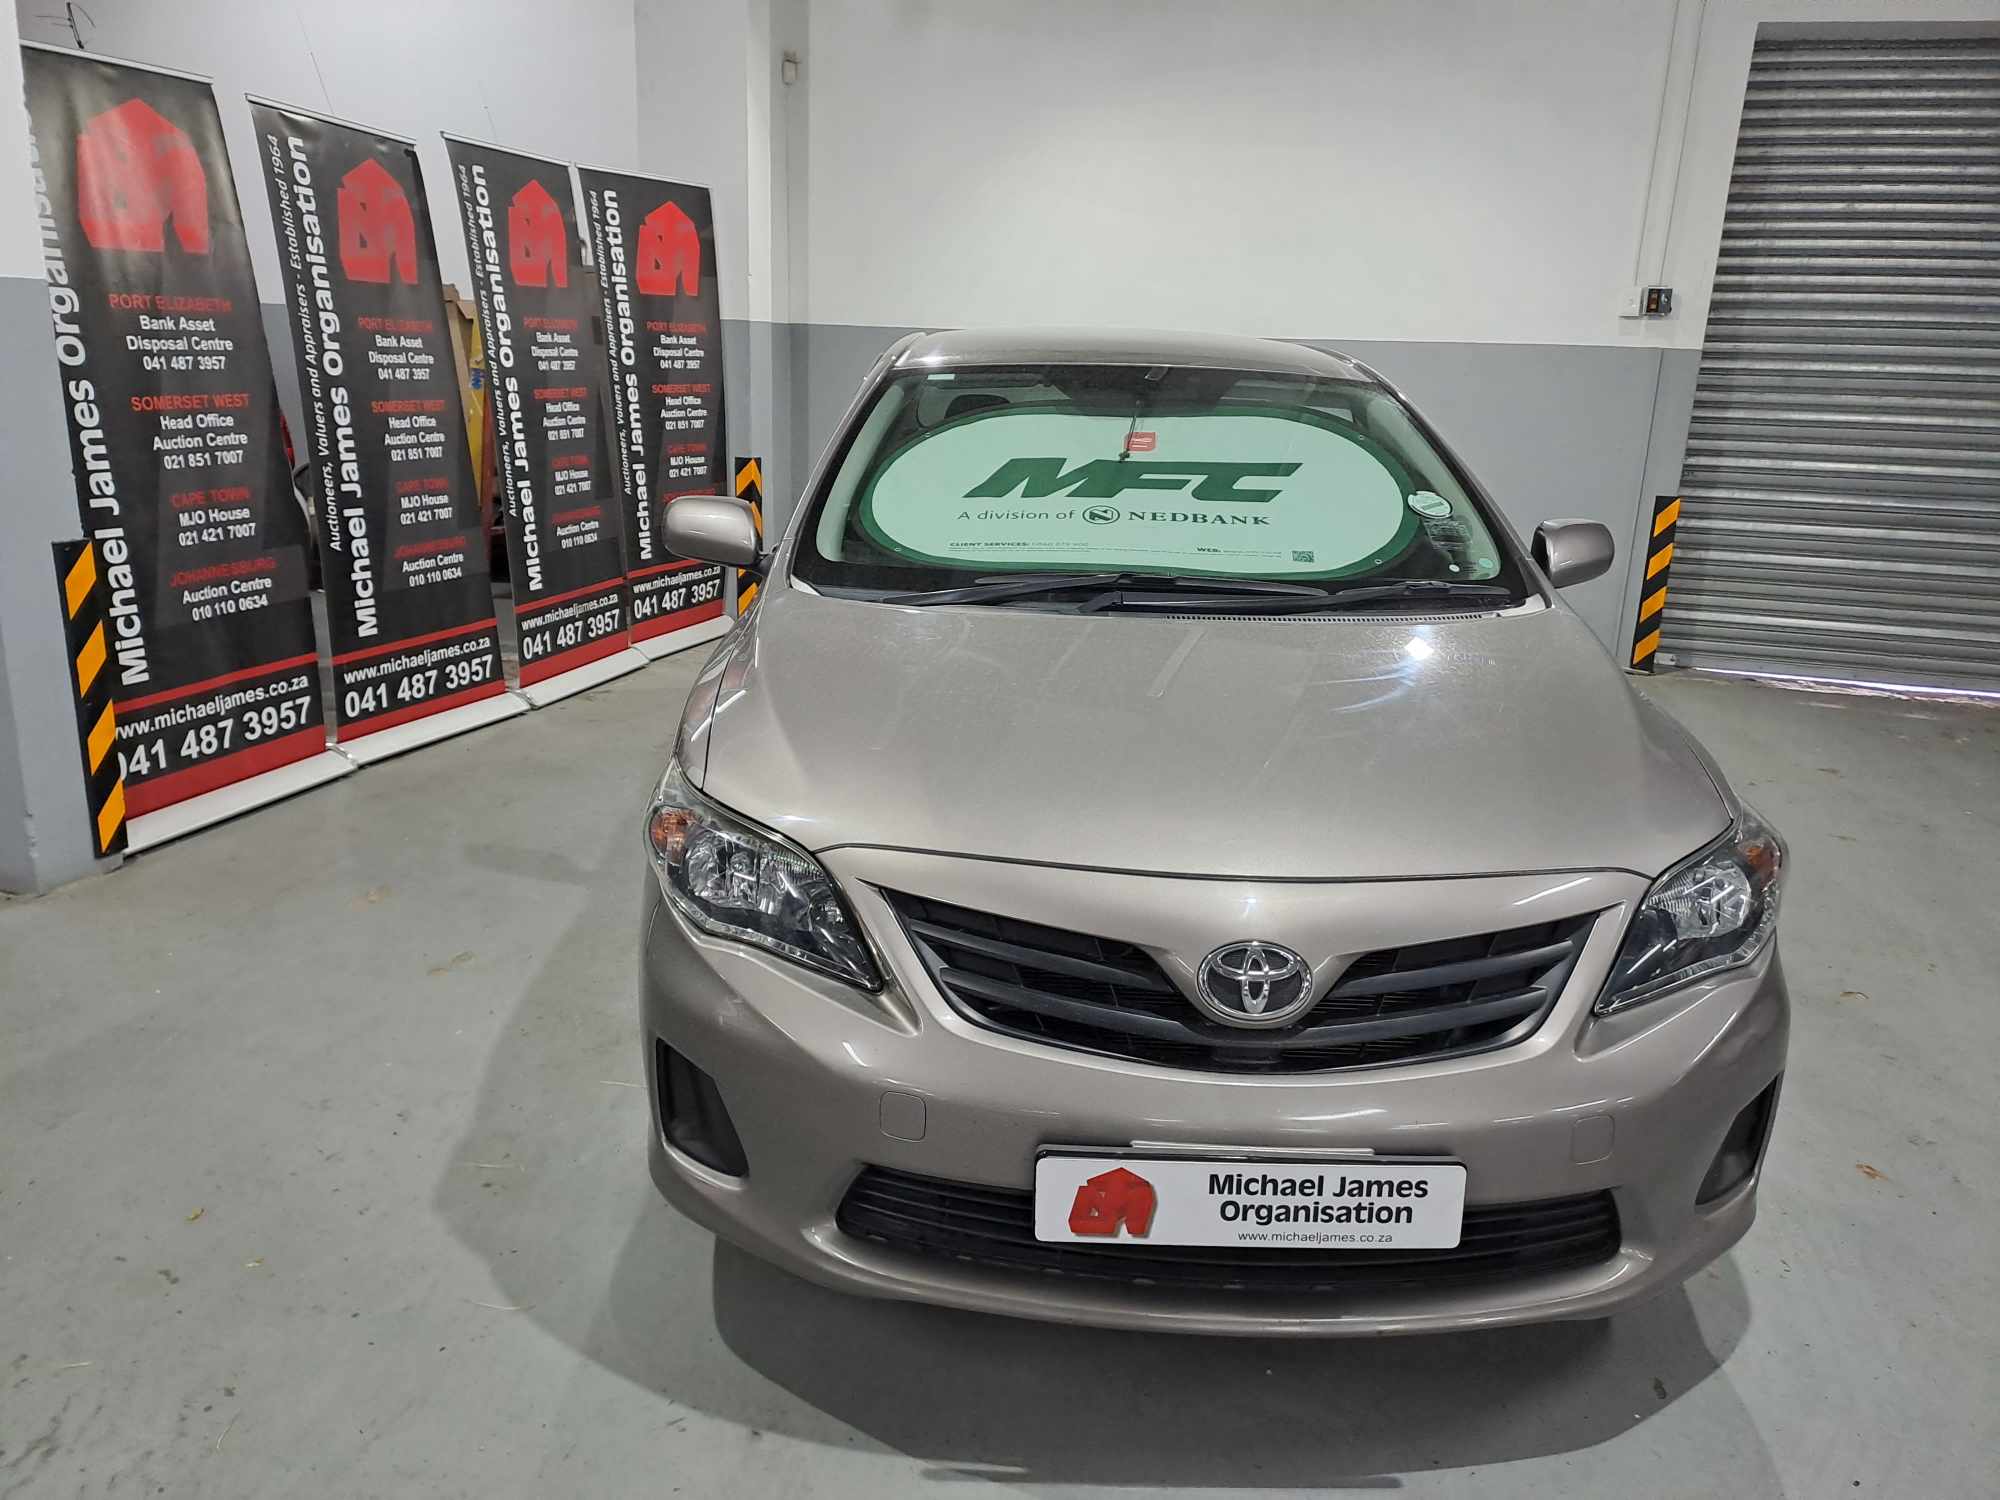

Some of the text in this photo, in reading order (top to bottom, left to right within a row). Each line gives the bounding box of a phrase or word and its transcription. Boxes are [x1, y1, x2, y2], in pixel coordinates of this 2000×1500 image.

[472, 164, 514, 368] Organisation
[108, 293, 151, 309] PORT
[139, 315, 216, 332] Bank Asset
[480, 288, 497, 358] Appraisers
[604, 298, 618, 361] Appraisers
[126, 336, 233, 352] Disposal Centre
[267, 134, 342, 551] Auctioneers, Valuers and Appraisers Established 1964
[375, 334, 423, 348] Bank Asset
[143, 356, 226, 370] 041 487 3957
[368, 351, 434, 365] Disposal Centre
[610, 359, 620, 381] and
[378, 368, 393, 380] 041
[395, 368, 410, 380] 487
[488, 359, 499, 386] and
[603, 190, 653, 560] Michael James Organisation
[288, 136, 379, 639] Michael James Organisation
[131, 393, 249, 411] SOMERSET WEST
[495, 388, 508, 436] Valuers
[613, 384, 623, 425] Valuers
[160, 413, 234, 430] Head Office
[388, 415, 436, 429] Head Office
[506, 376, 529, 472] James
[68, 379, 120, 516] James
[153, 432, 248, 451] Auction Centre
[384, 431, 445, 446] Auction Centre
[164, 450, 243, 470] 021 851 7007
[391, 450, 405, 461] 021
[408, 448, 423, 460] 851
[502, 441, 518, 517] Auctioneers,
[962, 457, 1303, 503] MFC
[401, 494, 448, 509] MJO House
[179, 508, 250, 526] MJO House
[400, 513, 416, 525] 021
[418, 511, 432, 523] 421
[958, 509, 1272, 526] A division of NEDBANK
[178, 523, 256, 546] 021 421 7007
[517, 480, 543, 592] Michael
[402, 552, 464, 573] Auction Centre
[182, 577, 272, 604] Auction Centre
[409, 574, 425, 587] 010
[428, 570, 442, 583] 110
[633, 566, 721, 593] www.michaeljames.co.za
[94, 527, 150, 686] Michael
[192, 594, 269, 621] 010 110 0634
[634, 579, 720, 619] 041 487 3957
[521, 594, 618, 631] www.michaeljames.co.za
[523, 608, 620, 660] 041 487 3957
[344, 636, 491, 685] www.michaeljames.co.za
[345, 654, 493, 718] 041 487 3957
[180, 718, 234, 759] 487
[243, 695, 311, 741] 3957
[1208, 1173, 1429, 1198] Michael James
[1219, 1200, 1414, 1226] Organisation
[1237, 1231, 1394, 1245] www.michaeljames.co.za
